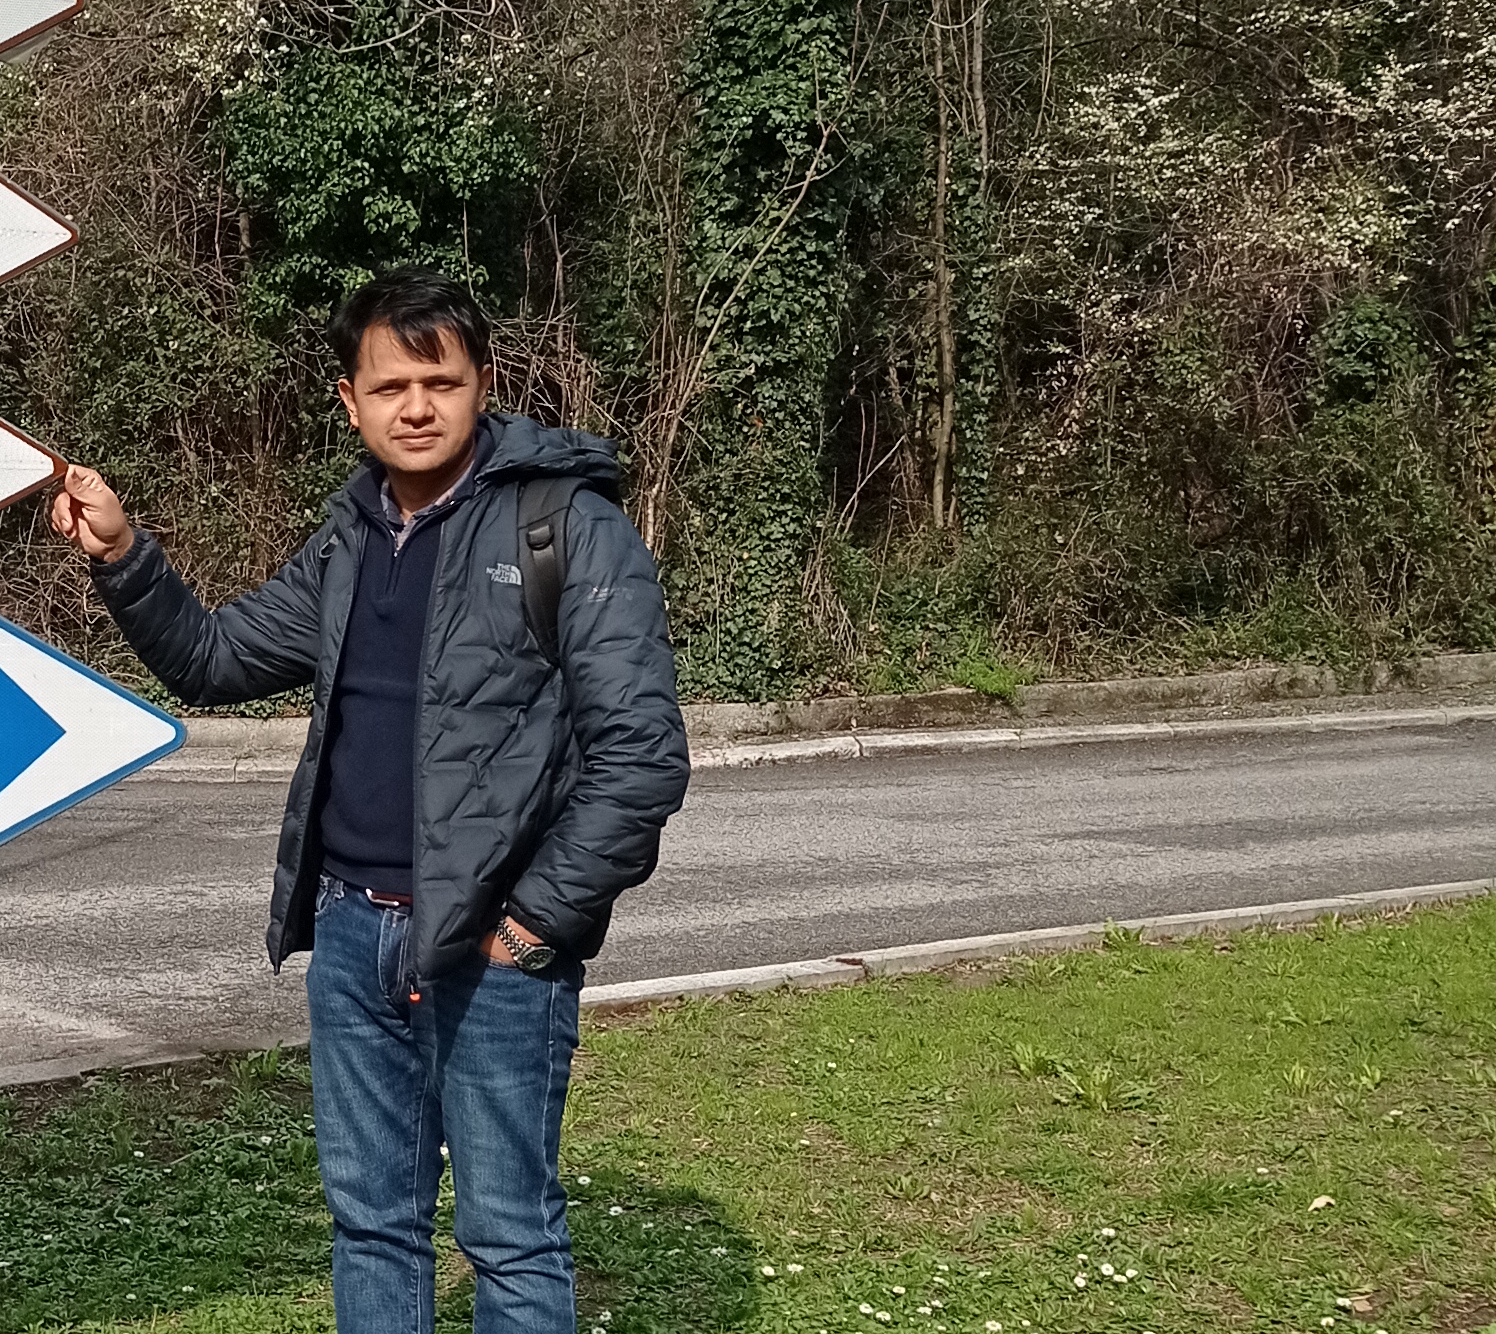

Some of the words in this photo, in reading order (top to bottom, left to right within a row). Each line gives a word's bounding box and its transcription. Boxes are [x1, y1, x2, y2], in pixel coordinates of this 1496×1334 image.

[497, 563, 512, 571] THE
[486, 567, 510, 578] NORTH
[491, 574, 510, 584] FACE
